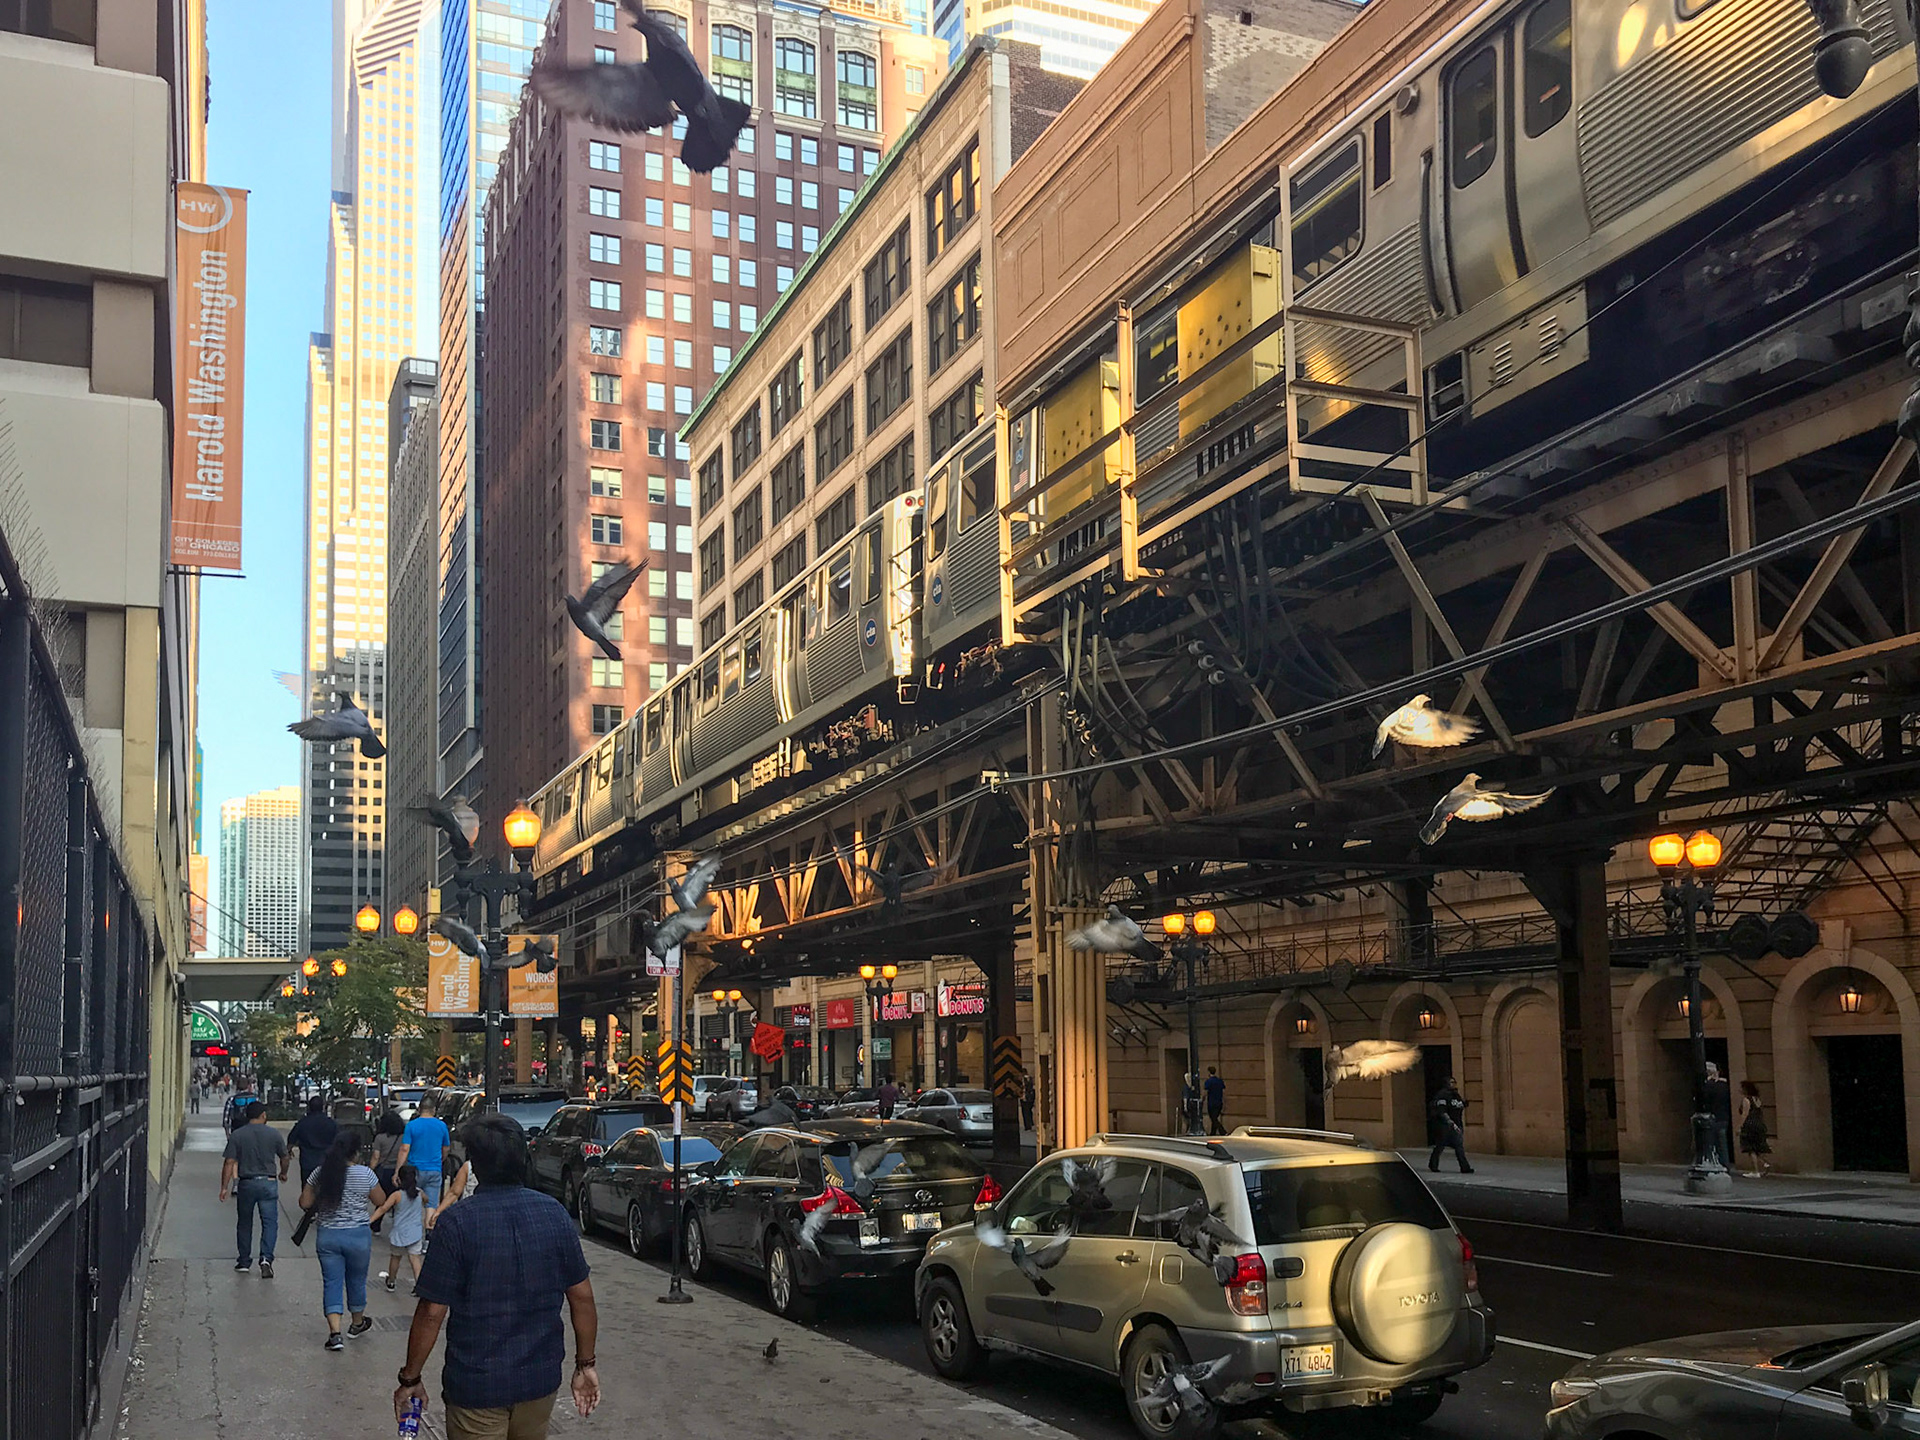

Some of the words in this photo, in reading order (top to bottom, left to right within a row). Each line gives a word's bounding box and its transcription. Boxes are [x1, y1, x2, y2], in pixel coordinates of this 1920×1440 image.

[181, 199, 216, 213] HW
[188, 250, 238, 404] Washington
[185, 413, 225, 502] Harold
[174, 535, 193, 543] CITY
[189, 542, 240, 552] CHICAGO
[525, 972, 556, 983] WORKS
[440, 974, 455, 1010] Harold
[949, 998, 984, 1016] DONUTS
[1399, 1291, 1440, 1308] TOYOTA
[1285, 1356, 1302, 1373] X71
[1308, 1354, 1332, 1371] 4842
